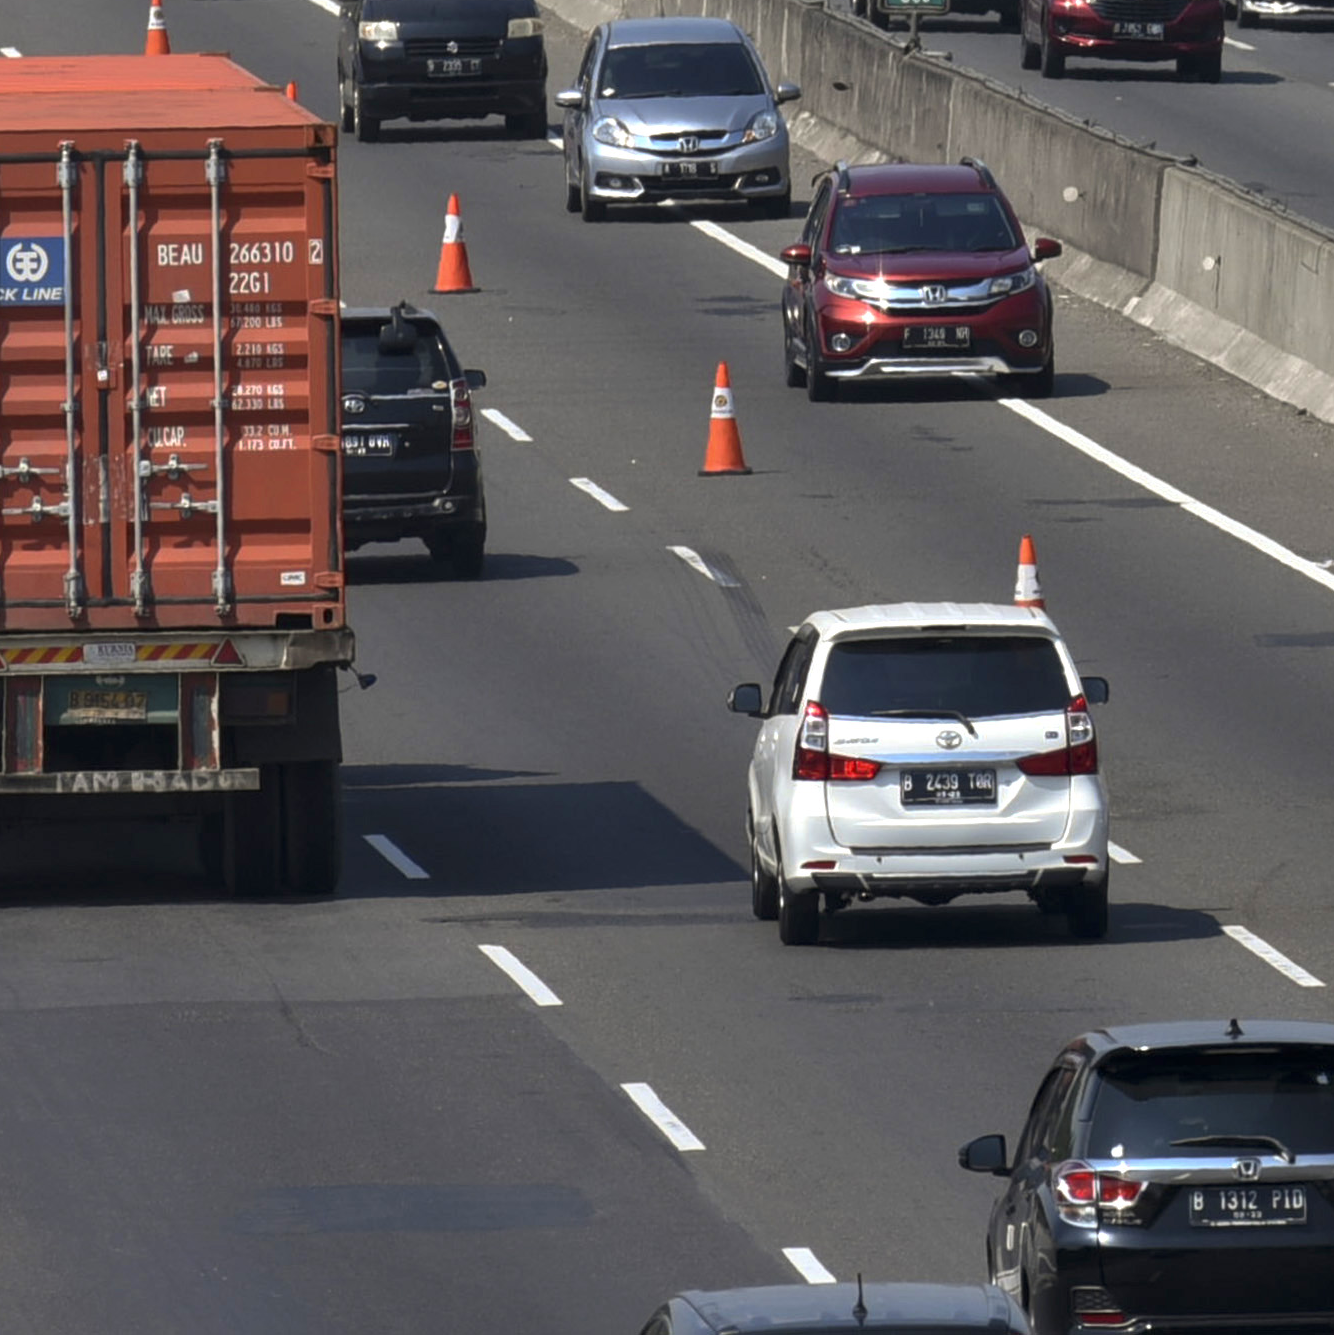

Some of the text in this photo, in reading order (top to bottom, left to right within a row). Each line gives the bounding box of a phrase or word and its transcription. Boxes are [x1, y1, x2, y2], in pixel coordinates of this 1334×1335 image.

[157, 240, 323, 266] BEAU 266310 2
[229, 271, 270, 294] 22G1
[22, 287, 64, 301] LINE
[171, 304, 205, 325] GROSS
[145, 345, 175, 365] TARE
[236, 343, 262, 355] 2.210
[146, 385, 167, 407] NET
[231, 398, 285, 411] 62.330 LBS
[243, 425, 264, 437] 33.2
[904, 775, 913, 791] B
[926, 773, 959, 791] 2439
[1193, 1189, 1304, 1211] B 1312 PID
